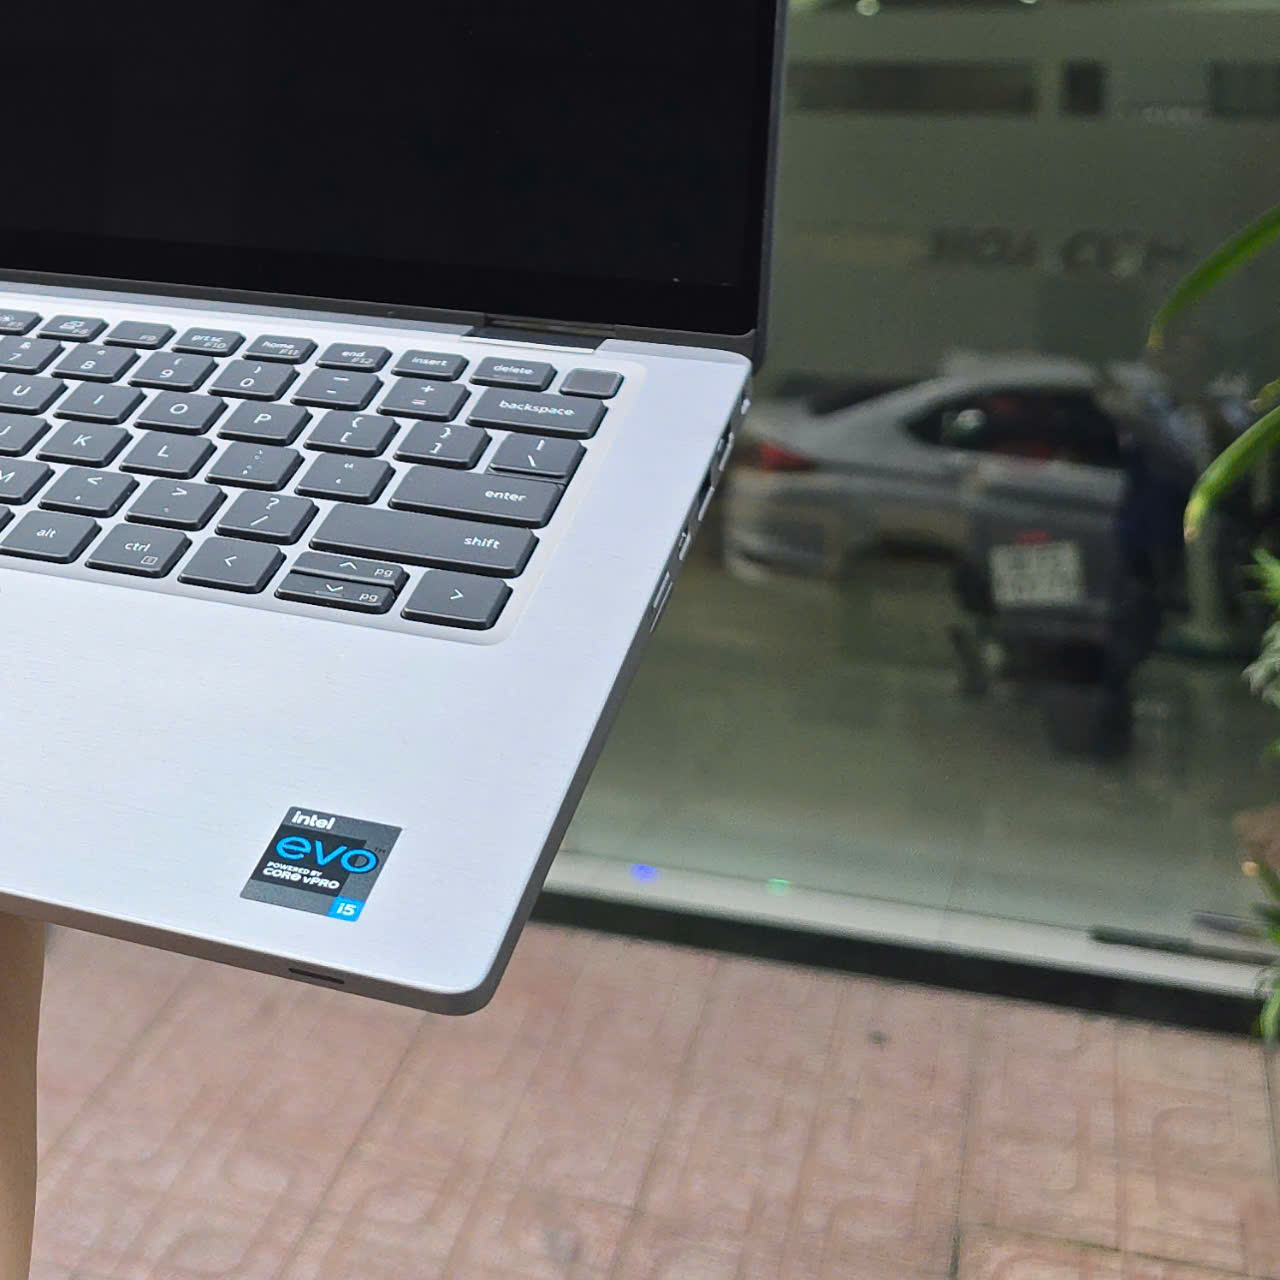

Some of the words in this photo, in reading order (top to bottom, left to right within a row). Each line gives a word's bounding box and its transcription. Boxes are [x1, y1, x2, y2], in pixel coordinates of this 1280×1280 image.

[262, 340, 296, 350] home
[341, 350, 367, 358] end
[411, 357, 449, 367] insert
[160, 370, 174, 378] 9
[493, 364, 534, 375] delete
[13, 385, 31, 395] U
[170, 404, 188, 414] O
[498, 400, 575, 417] backspace
[254, 414, 271, 423] P
[73, 435, 91, 446] K
[158, 446, 168, 457] L
[485, 491, 526, 501] enter
[37, 529, 56, 538] alt
[125, 543, 150, 551] ctrl
[464, 537, 500, 549] shift
[374, 568, 394, 578] pg
[359, 593, 379, 603] pg
[275, 835, 379, 874] evo
[267, 861, 309, 876] POWERED
[336, 902, 355, 916] i5
